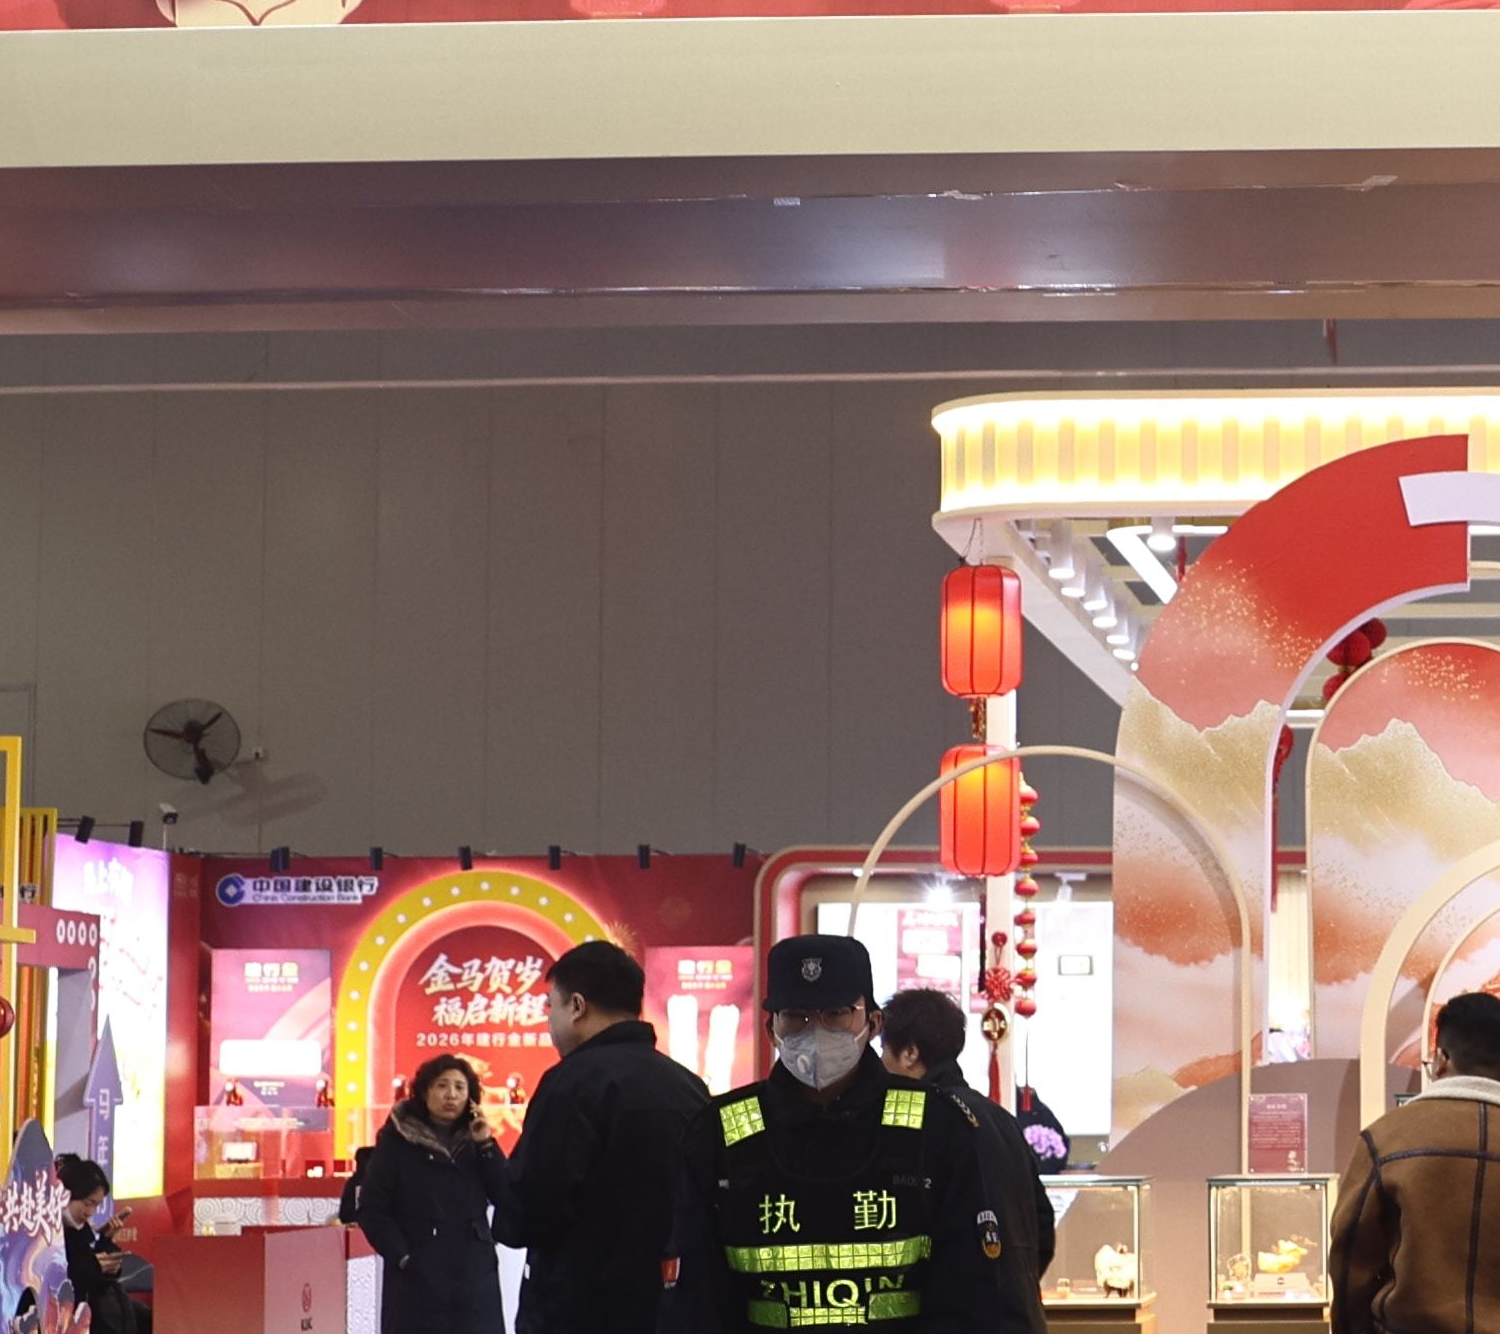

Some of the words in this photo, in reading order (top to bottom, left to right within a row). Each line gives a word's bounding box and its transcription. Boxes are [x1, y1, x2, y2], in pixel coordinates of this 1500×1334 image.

[252, 877, 378, 895] 中国建设银行
[418, 954, 545, 995] 金马贺岁
[431, 992, 550, 1028] 福启新程
[759, 1193, 801, 1234] 执
[852, 1188, 898, 1231] 勤
